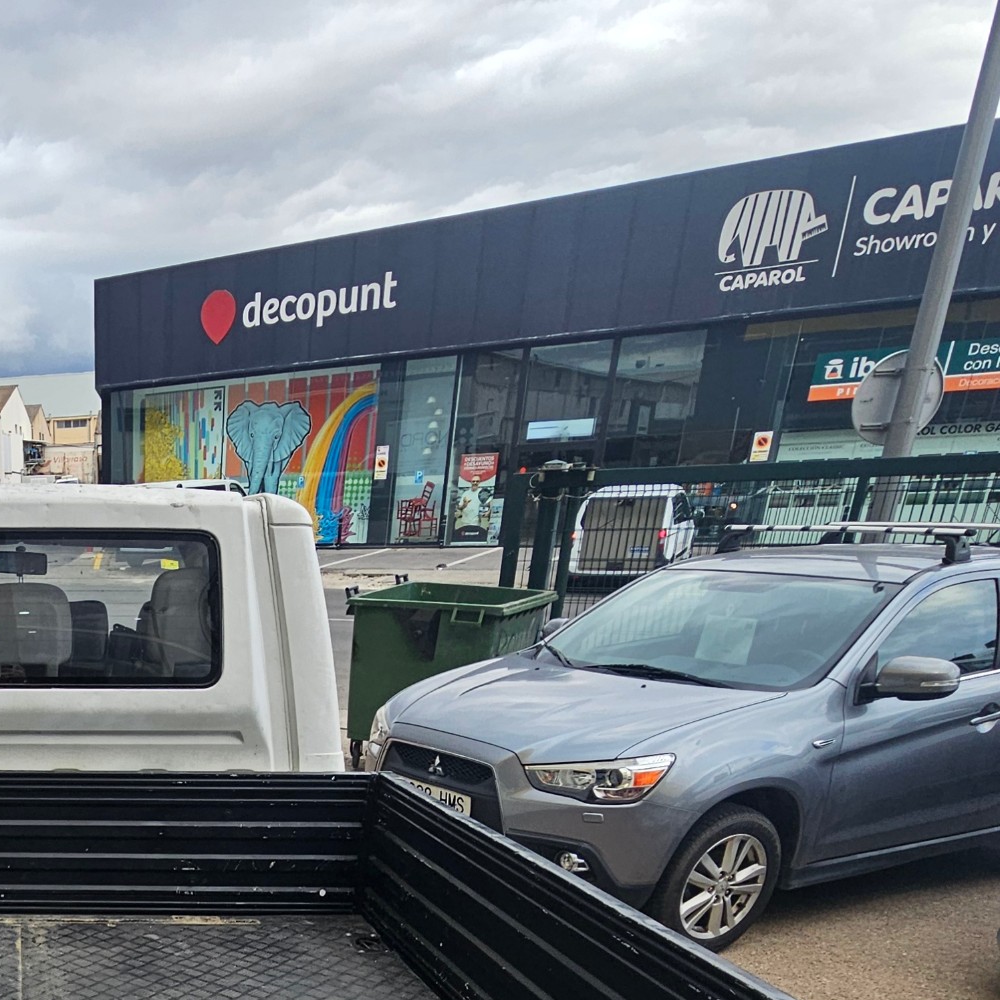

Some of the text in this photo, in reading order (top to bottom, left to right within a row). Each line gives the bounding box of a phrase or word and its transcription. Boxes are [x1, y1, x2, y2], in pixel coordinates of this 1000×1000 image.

[863, 171, 1000, 225] CAPR
[853, 223, 997, 256] Showro y
[719, 266, 806, 292] CAPAROL
[242, 271, 398, 328] decopunt
[968, 342, 1000, 356] Des
[963, 359, 992, 371] con
[940, 423, 982, 435] COLOR
[440, 790, 464, 813] HMS
